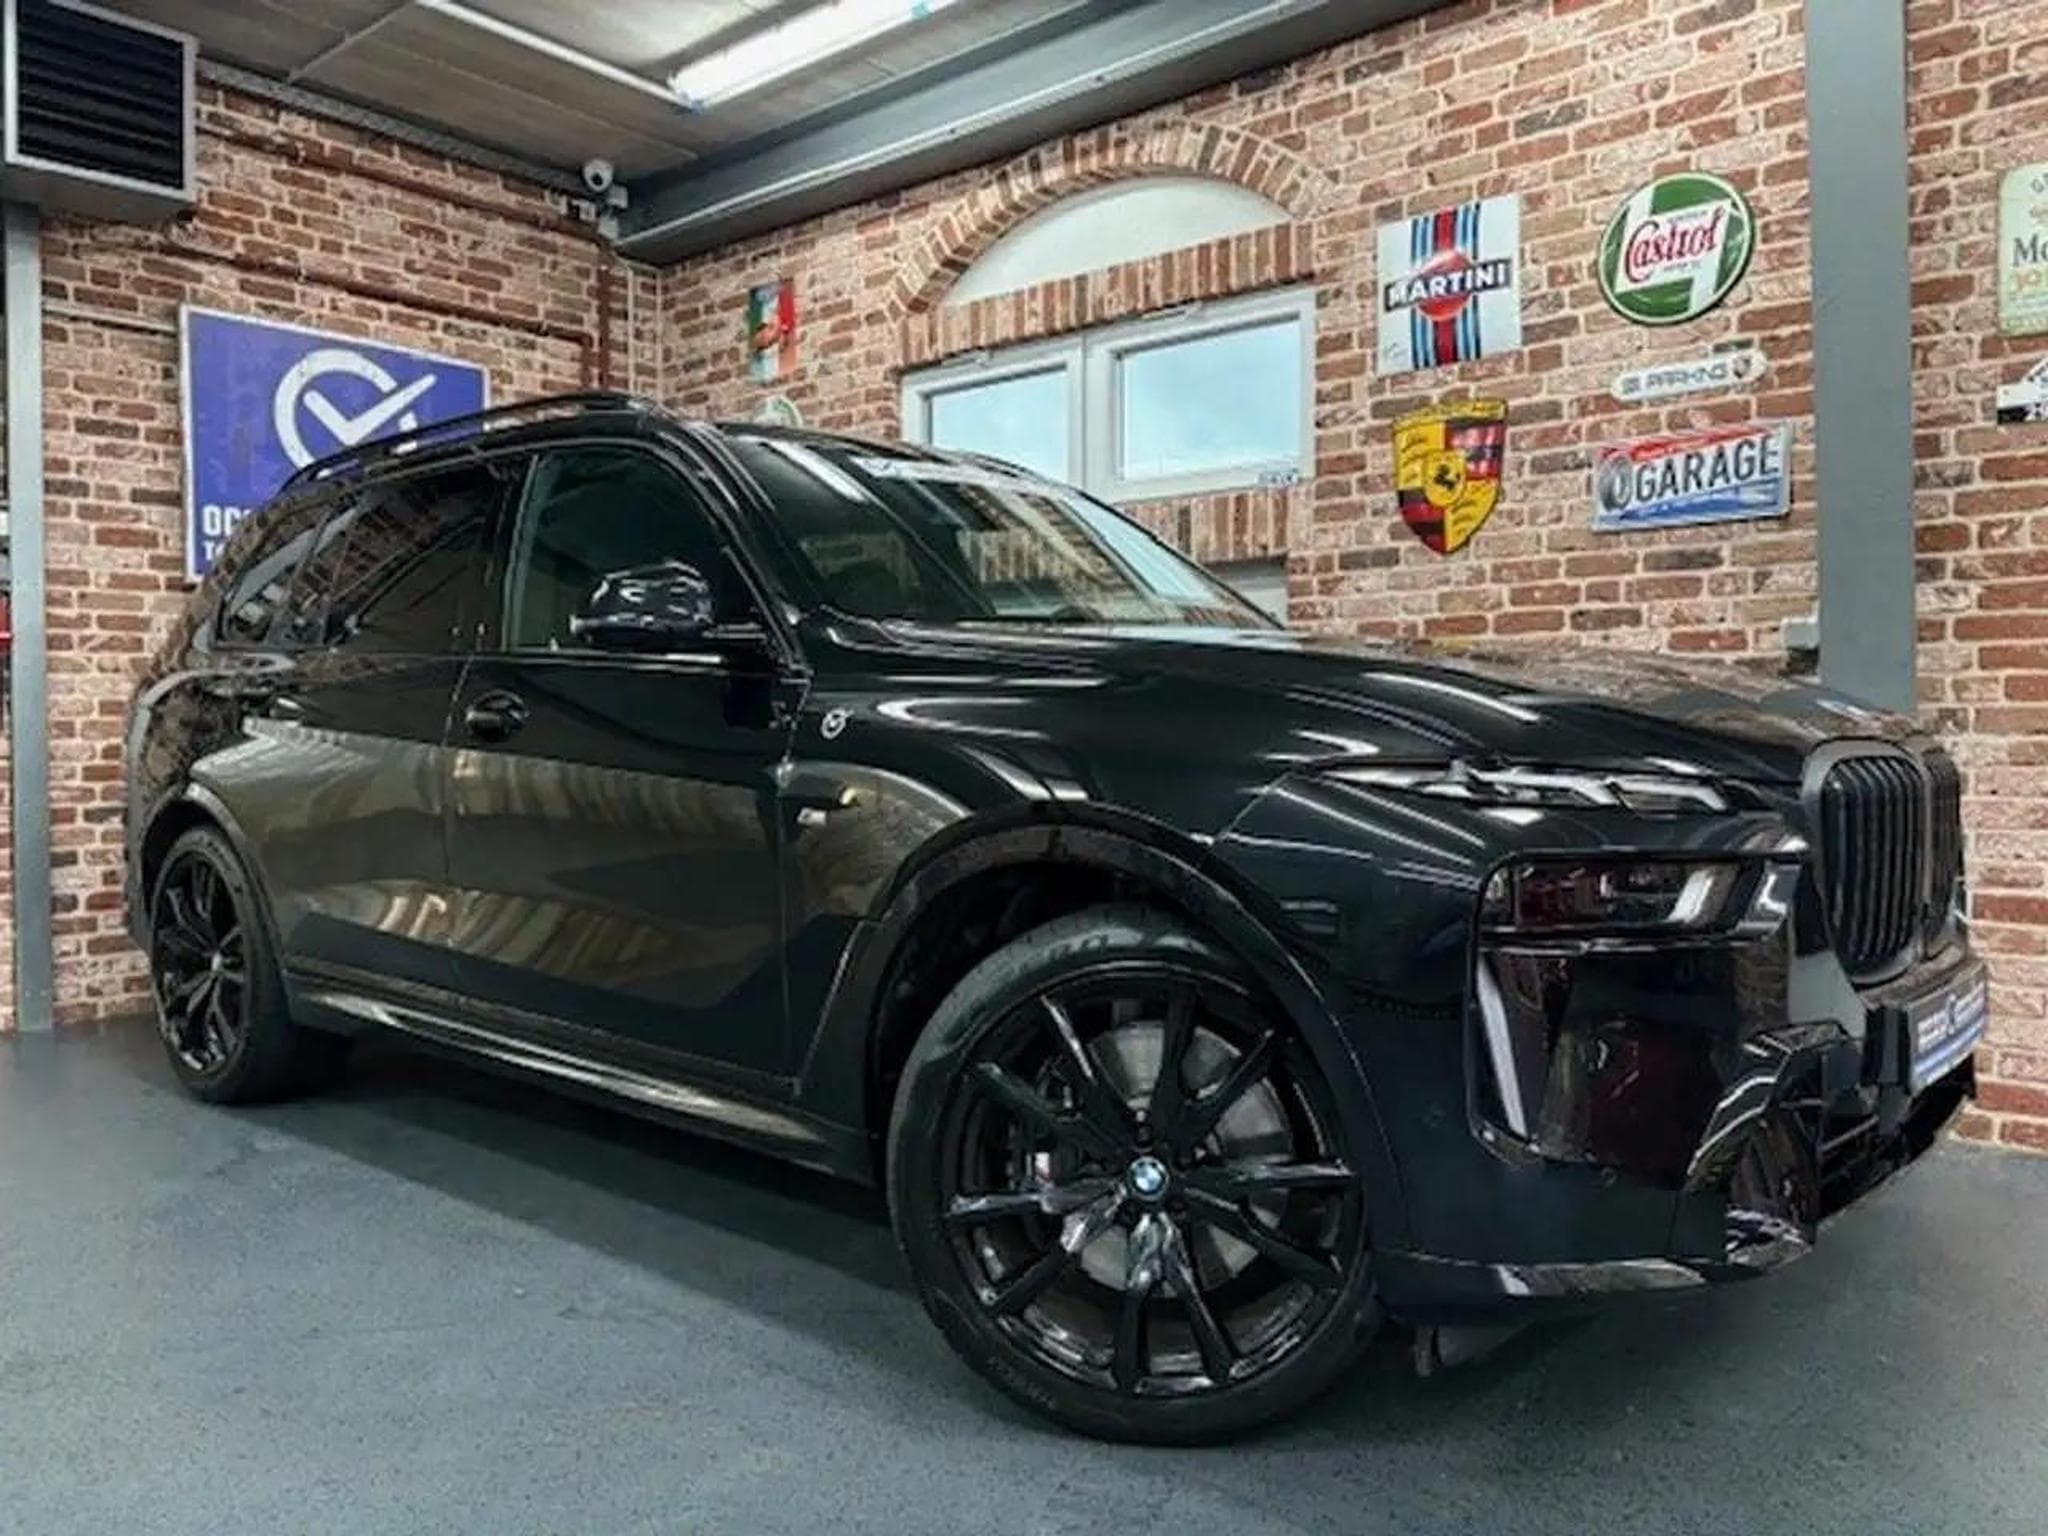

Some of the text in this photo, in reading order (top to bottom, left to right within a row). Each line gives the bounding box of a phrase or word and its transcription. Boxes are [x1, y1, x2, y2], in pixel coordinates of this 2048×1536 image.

[1625, 205, 1725, 283] Castrol
[1387, 262, 1507, 308] MARTINI
[1635, 433, 1779, 502] GARAGE
